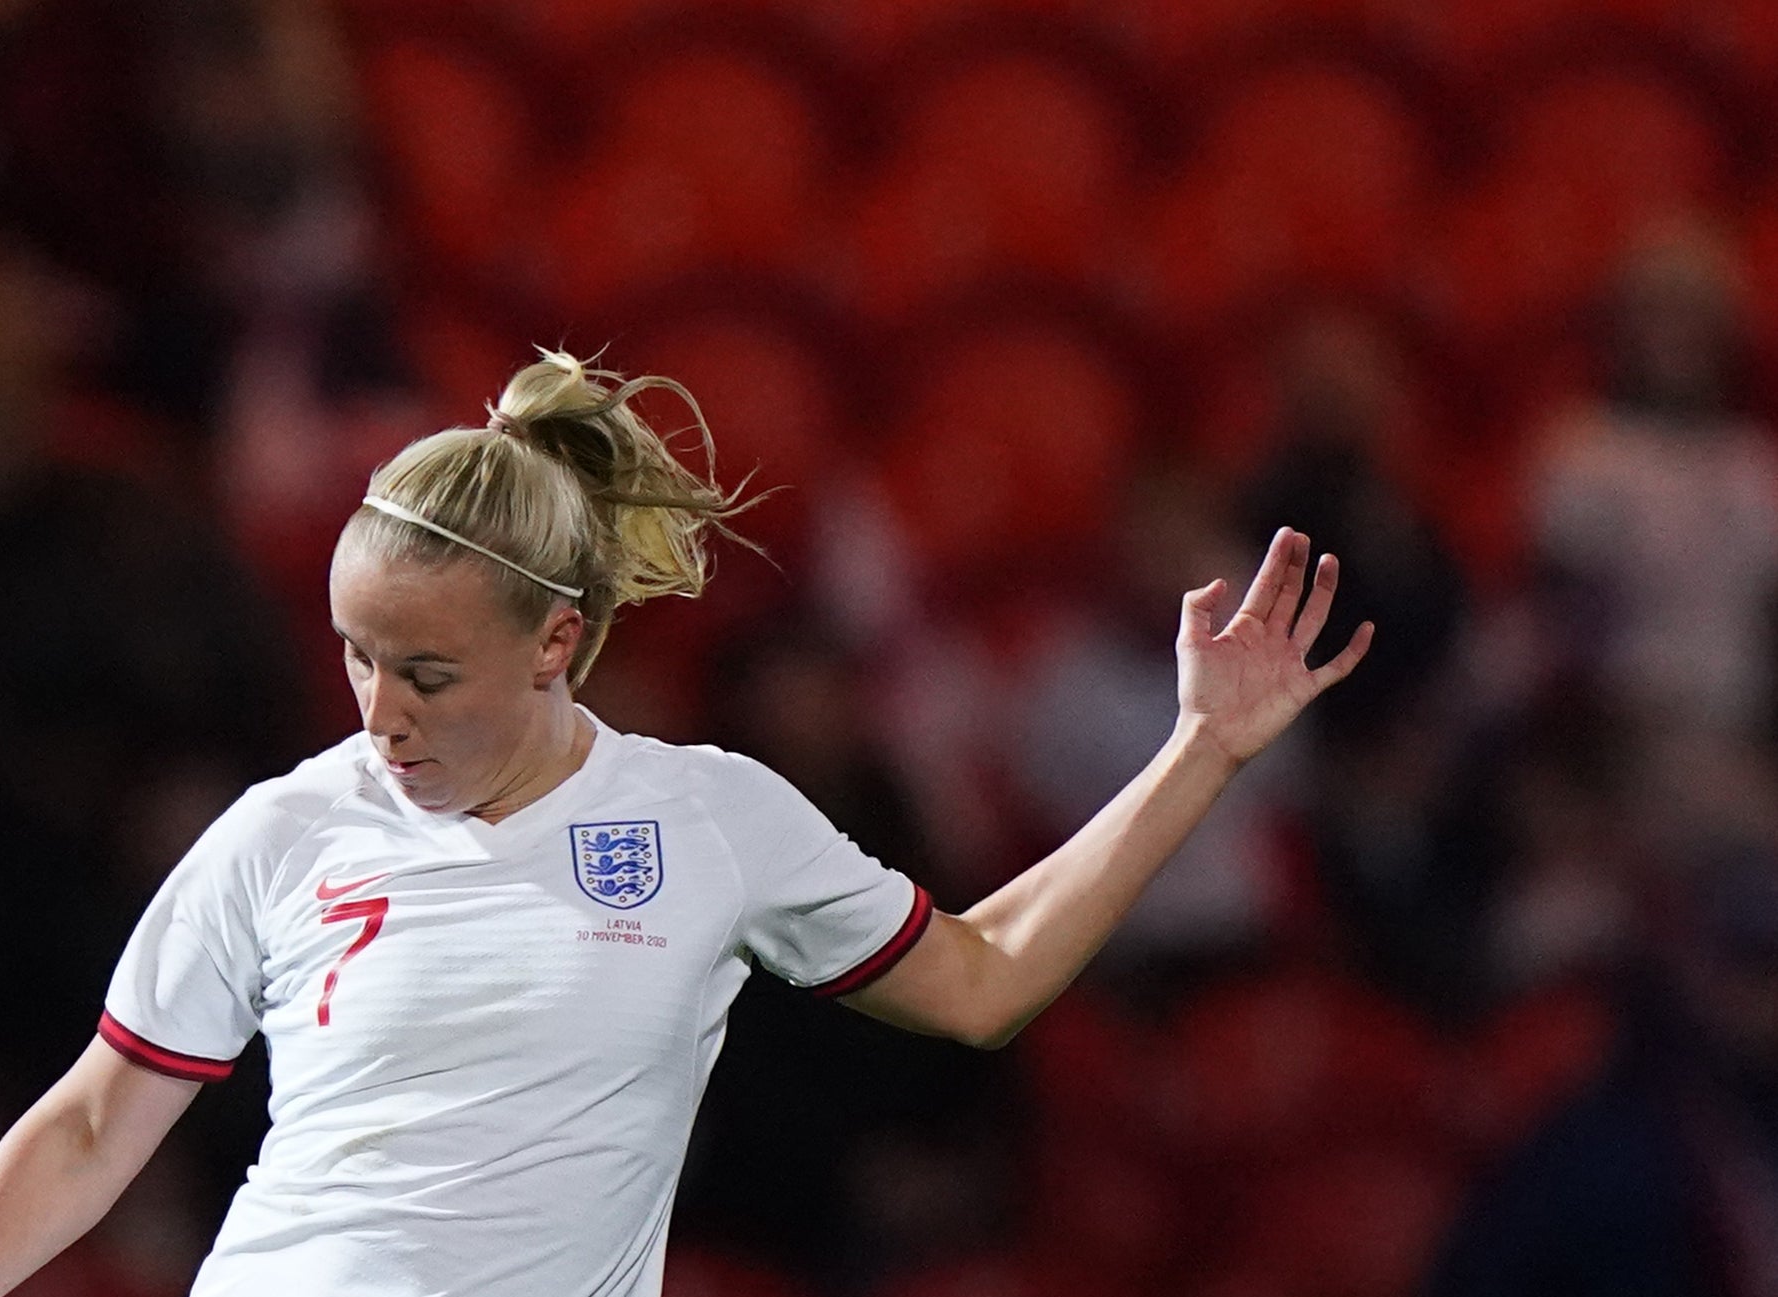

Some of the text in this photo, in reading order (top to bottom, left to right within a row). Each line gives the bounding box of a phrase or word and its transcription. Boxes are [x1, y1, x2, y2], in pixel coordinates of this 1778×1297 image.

[606, 918, 642, 931] LATVIA
[576, 930, 589, 942] 30
[591, 931, 644, 945] NOVEMBER
[318, 897, 389, 1026] 7
